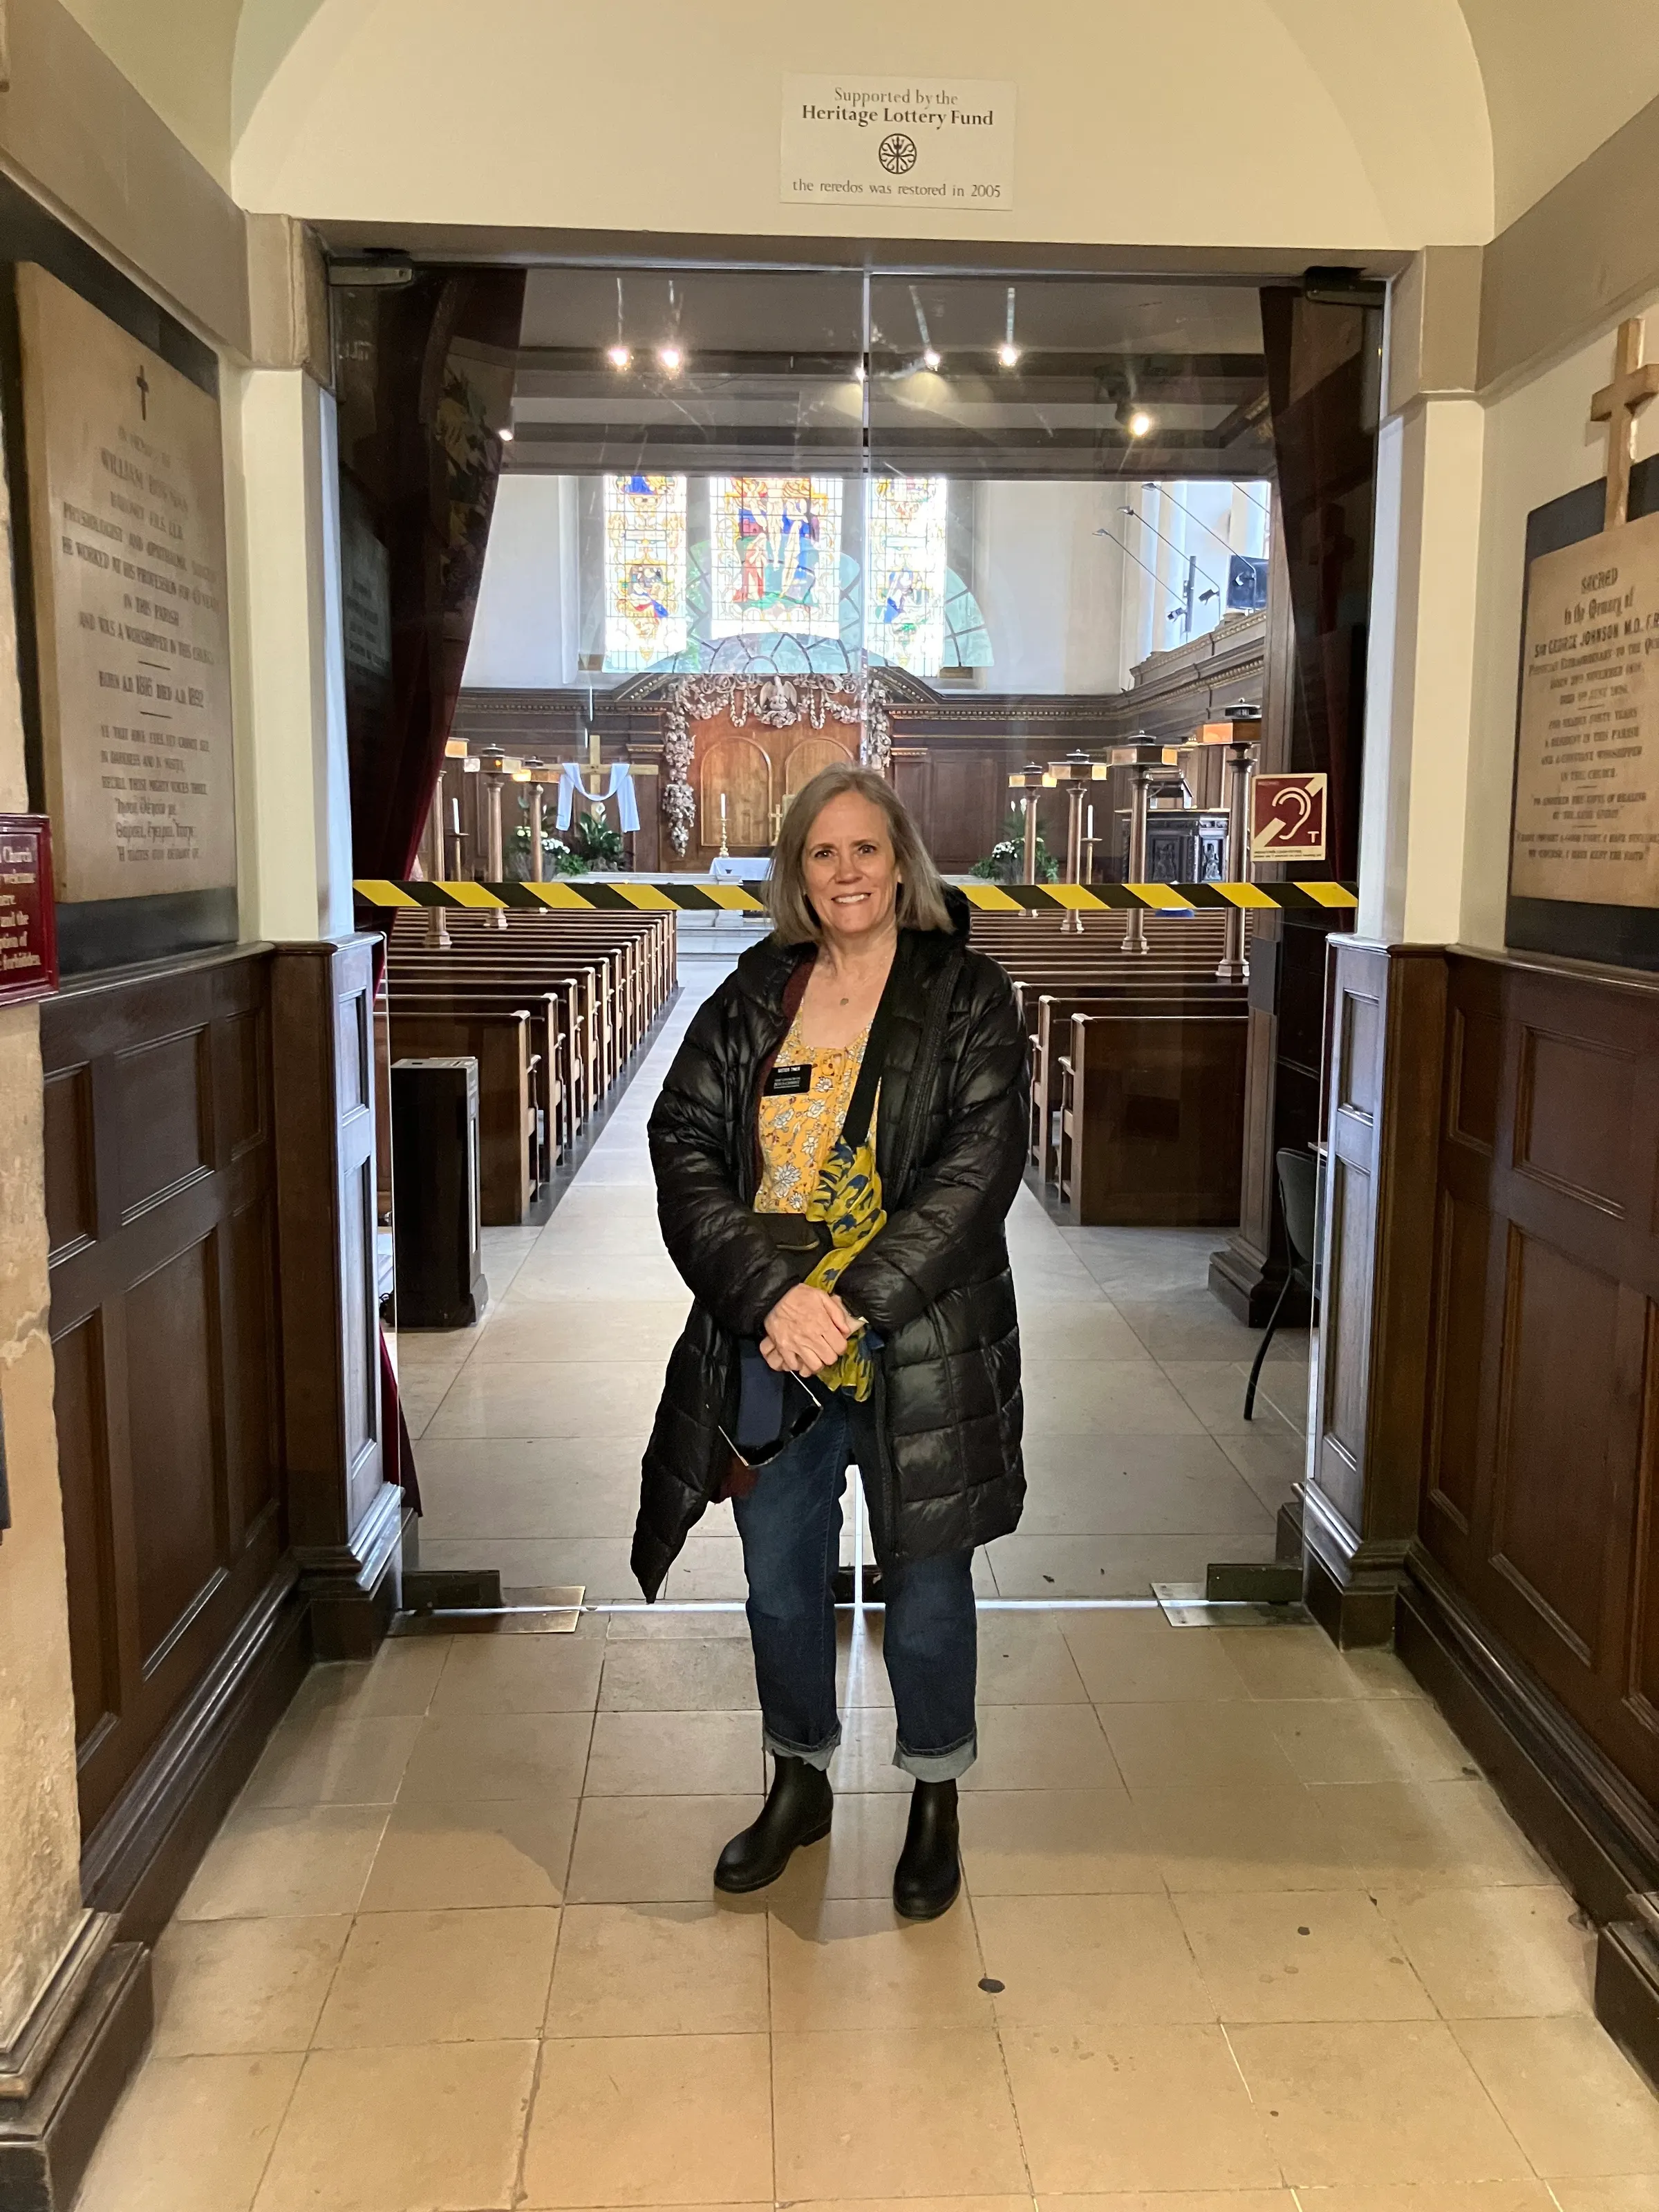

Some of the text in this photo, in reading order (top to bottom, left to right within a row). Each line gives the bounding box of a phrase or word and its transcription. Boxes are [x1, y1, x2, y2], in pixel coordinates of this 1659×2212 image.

[834, 87, 958, 109] Supported by the
[802, 104, 994, 130] Heritage Lottery Fund
[793, 178, 1001, 198] the reredos was restored in 2005
[1580, 624, 1618, 646] JOHNSON
[1307, 831, 1320, 843] T
